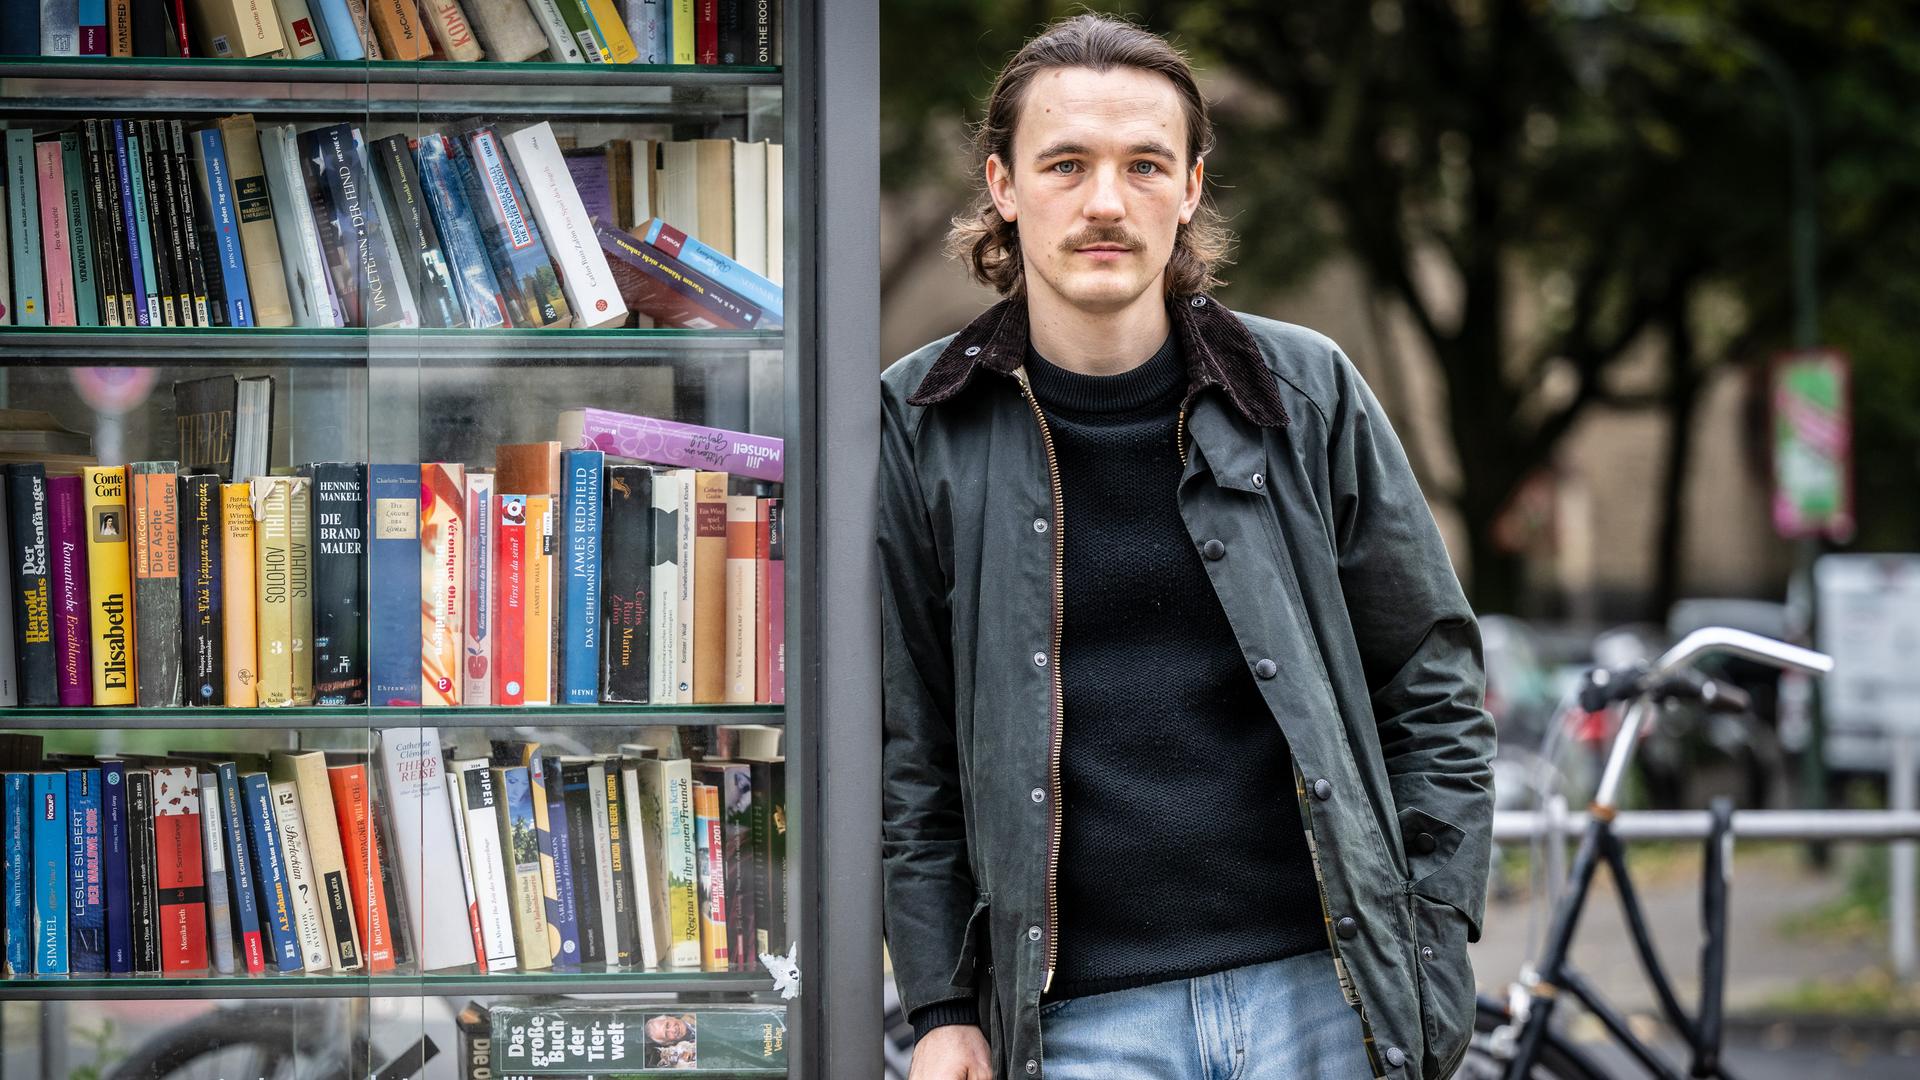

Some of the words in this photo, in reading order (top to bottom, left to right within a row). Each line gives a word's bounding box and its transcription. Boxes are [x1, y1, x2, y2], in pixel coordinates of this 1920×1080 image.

[758, 29, 768, 46] THE
[758, 47, 768, 62] ON
[334, 140, 345, 162] HEYNE
[479, 136, 493, 158] 10287
[212, 157, 221, 175] Liebe
[494, 163, 511, 188] TROIA
[215, 176, 224, 193] mehr
[338, 165, 356, 200] FEIND
[503, 186, 516, 204] VON
[218, 193, 226, 205] Tag
[498, 193, 515, 219] ZIMMER
[220, 206, 230, 224] Jeden
[349, 202, 365, 228] DER
[509, 203, 524, 228] FEUER
[225, 235, 234, 249] GRAY
[507, 217, 524, 245] MARION
[518, 227, 529, 243] DIE
[228, 250, 238, 269] JOHN
[641, 254, 659, 269] nicht
[682, 276, 705, 295] Warum
[733, 442, 780, 461] Mansell
[745, 455, 762, 469] Jill
[93, 472, 123, 485] Conte
[95, 484, 122, 498] Corti
[320, 481, 361, 491] HENNING
[163, 481, 176, 526] Mutter
[320, 492, 362, 502] MANKELL
[575, 467, 586, 533] REDFIELD
[587, 467, 597, 533] SHAMBHALA
[31, 476, 48, 576] Seelenfänger
[137, 506, 147, 547] McCourt
[150, 508, 163, 547] Asche
[320, 513, 342, 525] DIE
[320, 527, 361, 540] BRAND
[165, 529, 176, 573] meiner
[320, 542, 362, 554] MAUER
[445, 516, 458, 582] Véronique
[509, 537, 519, 557] sein?
[573, 537, 587, 578] JAMES
[586, 536, 595, 561] VON
[22, 547, 36, 576] Der
[138, 549, 147, 575] Frank
[151, 551, 163, 573] Die
[509, 557, 519, 570] da
[62, 540, 75, 613] Romantische
[509, 570, 519, 584] du
[447, 585, 457, 616] Olmi
[509, 585, 519, 608] Wirst
[585, 563, 595, 625] GEHEIMNIS
[25, 588, 38, 645] Harold
[37, 577, 50, 644] Robbins
[65, 611, 80, 686] Erzählungen
[102, 592, 128, 691] Elisabeth
[270, 640, 283, 655] 3
[585, 627, 594, 649] DAS
[621, 626, 633, 667] Marina
[397, 757, 437, 772] THEOS
[481, 771, 494, 806] PIPER
[606, 774, 617, 801] MEDIEN
[669, 779, 678, 804] Kette
[678, 777, 690, 824] Freunde
[228, 787, 238, 816] LEOPARD
[259, 795, 270, 819] Grande
[608, 803, 619, 826] NEUEN
[85, 808, 98, 834] CODE
[263, 818, 272, 832] Rio
[610, 825, 619, 840] DER
[670, 804, 681, 836] Ursula
[73, 808, 84, 866] SILBERT
[234, 828, 242, 842] WIE
[681, 823, 693, 855] neuen
[713, 825, 722, 846] 2001
[86, 836, 99, 883] MARLOWE
[237, 843, 247, 876] SCHATTEN
[268, 847, 278, 868] Yukon
[284, 824, 303, 880] Sherlockian
[611, 842, 622, 872] LEXIKON
[271, 866, 280, 882] Vom
[681, 856, 693, 877] ihre
[75, 869, 85, 917] LESLIE
[87, 884, 99, 905] DER
[682, 878, 694, 898] und
[178, 908, 186, 924] Feth
[275, 882, 290, 931] A.E.Johann
[371, 907, 383, 946] MICHAELA
[685, 899, 697, 941] Regina
[46, 915, 57, 967] SIMMEL
[180, 924, 189, 951] Monika
[250, 937, 258, 956] pocket
[473, 1038, 490, 1065] Die
[507, 1025, 525, 1058] Das
[528, 1015, 550, 1068] große
[548, 1019, 565, 1063] Buch
[567, 1025, 585, 1056] der
[587, 1020, 605, 1063] Tier-
[607, 1022, 625, 1061] welt
[763, 1022, 772, 1057] Weltbild
